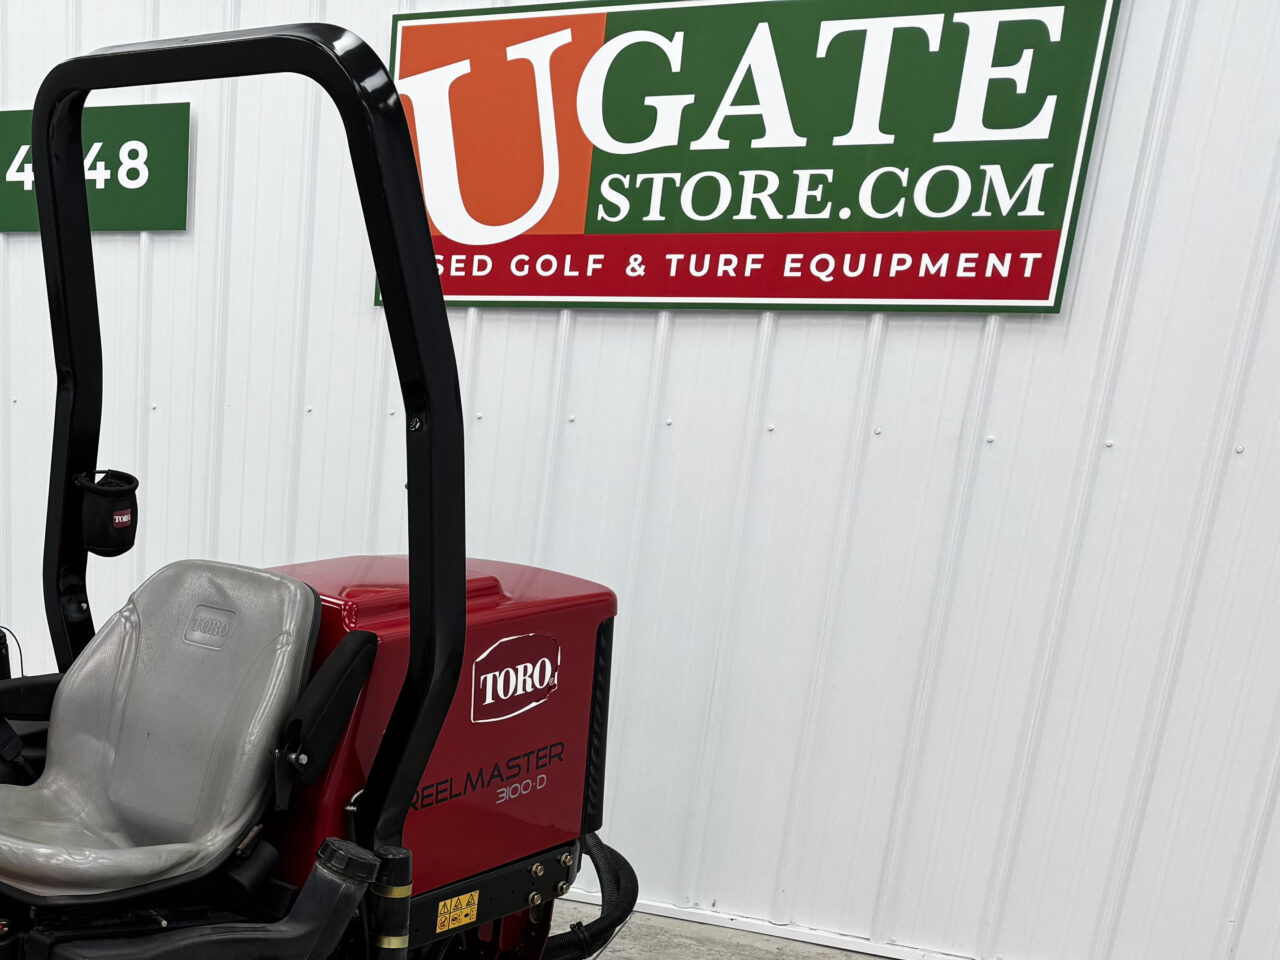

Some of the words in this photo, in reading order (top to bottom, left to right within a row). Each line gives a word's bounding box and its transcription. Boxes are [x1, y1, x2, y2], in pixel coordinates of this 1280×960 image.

[597, 163, 1055, 223] STORE.COM
[434, 253, 493, 277] SED
[510, 253, 605, 277] GOLF
[625, 253, 646, 277] &
[665, 253, 765, 277] TURF
[783, 252, 1043, 282] EQUIPMENT
[480, 657, 552, 706] TORO
